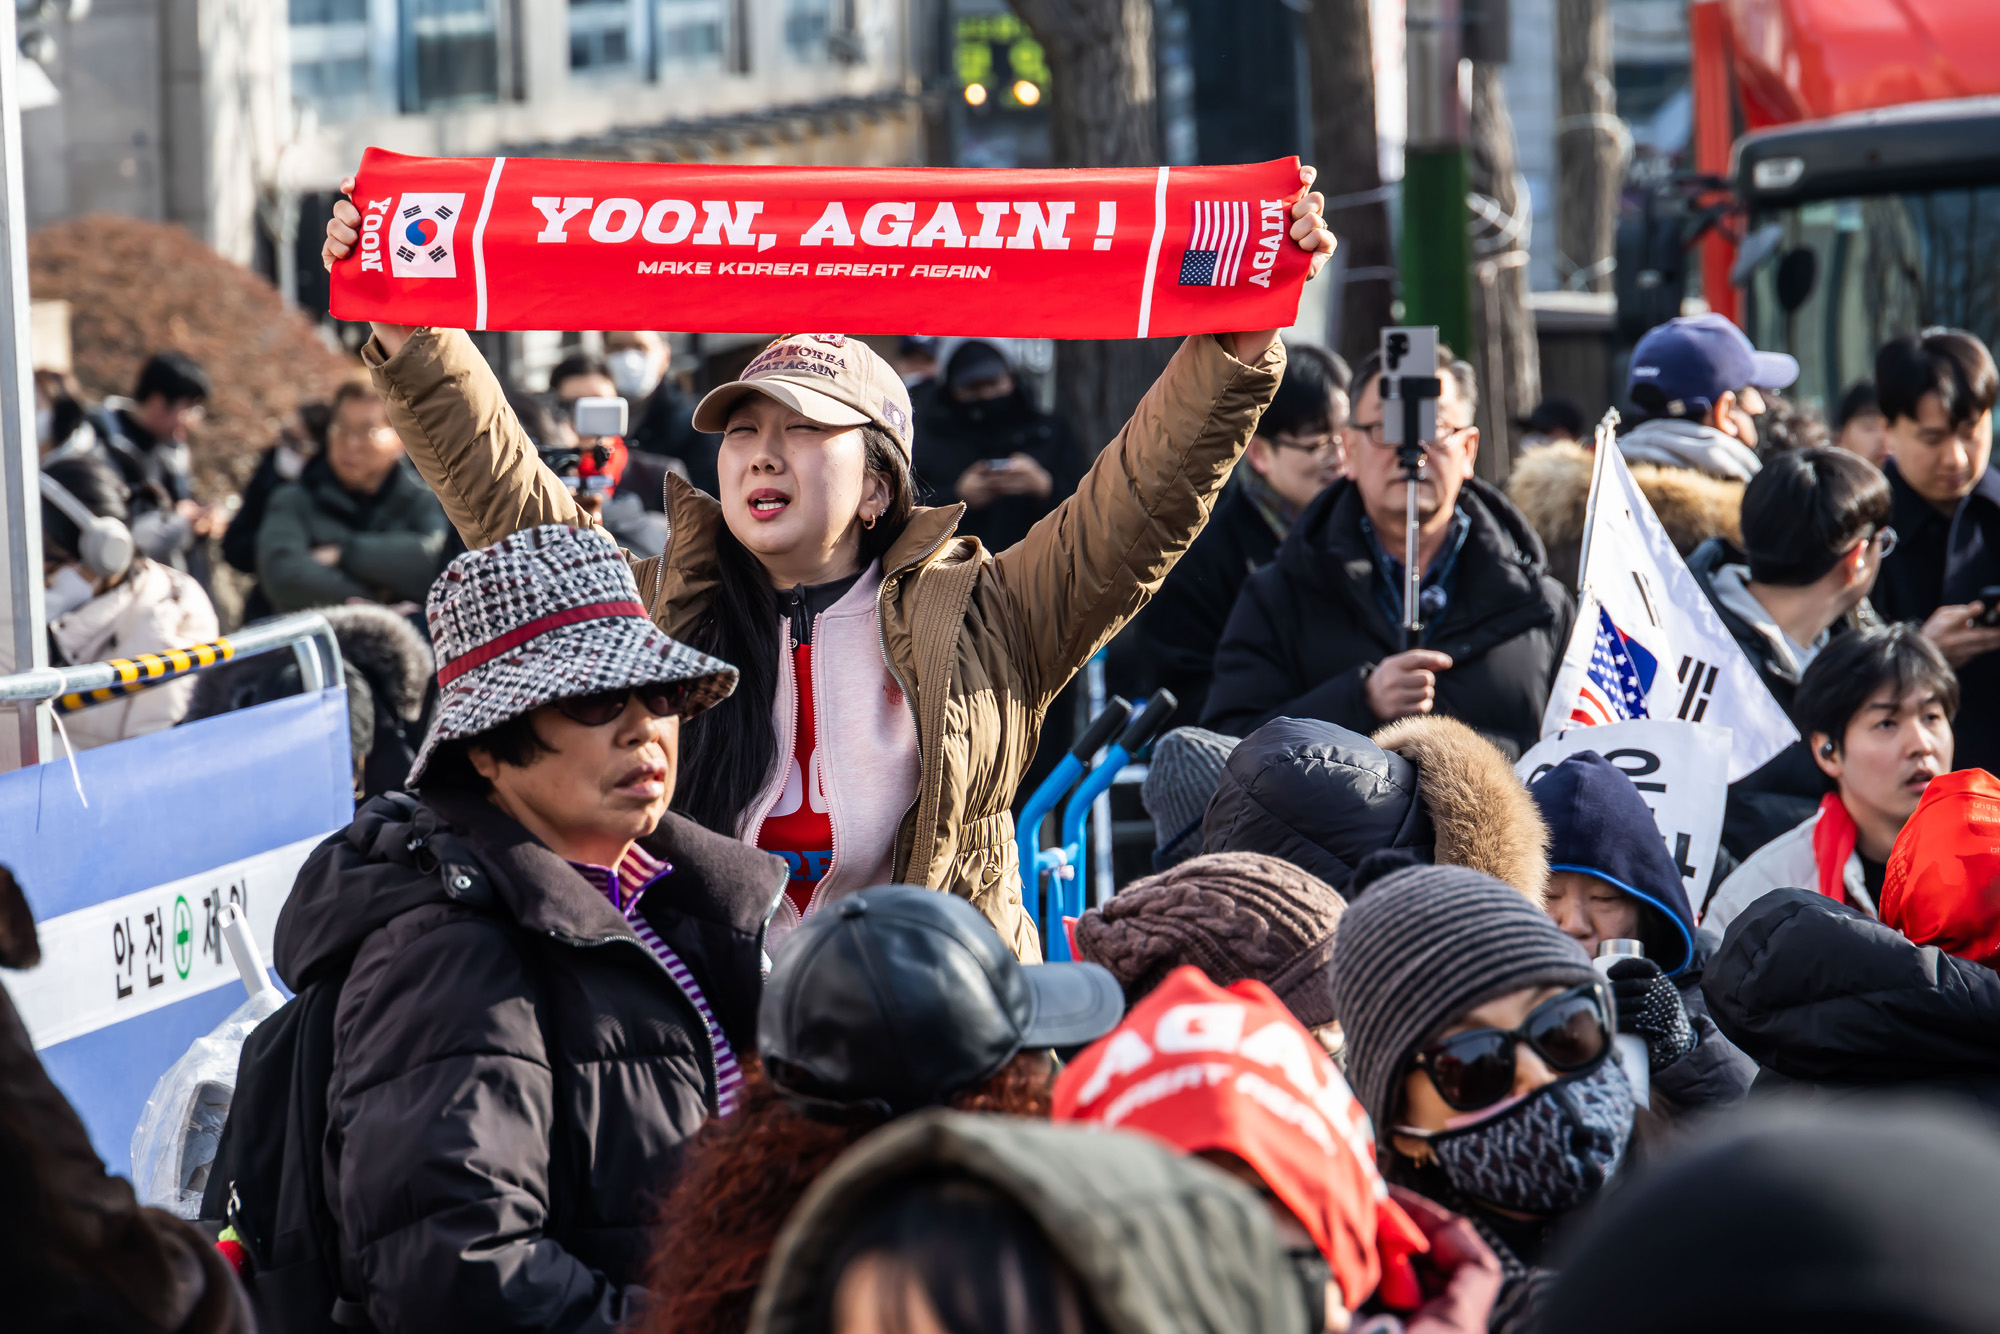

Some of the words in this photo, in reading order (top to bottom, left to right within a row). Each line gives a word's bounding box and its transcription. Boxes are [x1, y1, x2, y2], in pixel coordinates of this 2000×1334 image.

[361, 197, 392, 272] YOON
[531, 196, 777, 253] YOON,
[800, 201, 1075, 250] AGAIN
[1093, 200, 1117, 251] !
[1249, 199, 1284, 288] AGAIN
[637, 261, 712, 275] MAKE
[718, 262, 809, 276] KOREA
[815, 263, 905, 277] GREAT
[910, 265, 992, 279] AGAIN
[783, 360, 839, 379] AGAIN
[786, 344, 847, 369] KOREA
[113, 906, 164, 999] 안전
